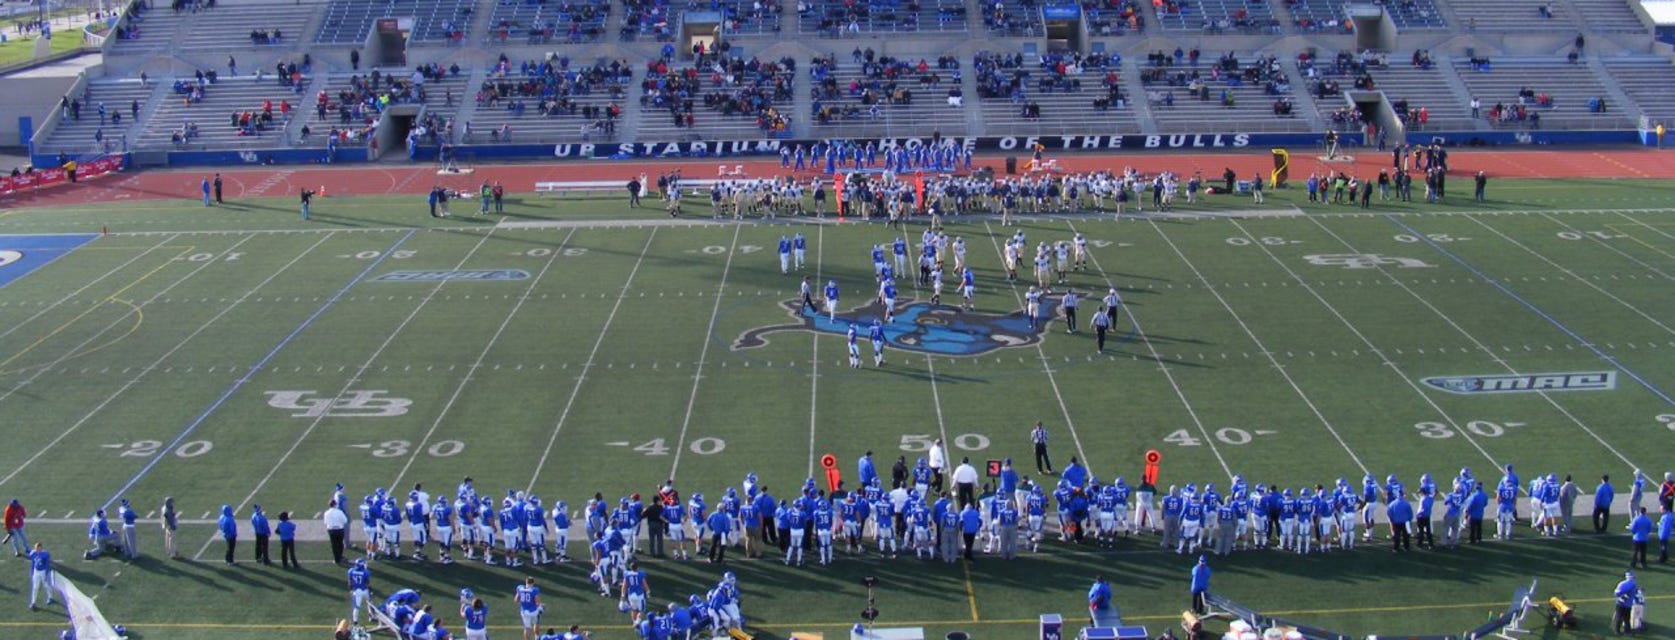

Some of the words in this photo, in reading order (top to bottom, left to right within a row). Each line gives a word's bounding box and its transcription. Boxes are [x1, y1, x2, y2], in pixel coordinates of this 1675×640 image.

[1000, 138, 1040, 149] OF
[1061, 135, 1122, 148] THE
[1145, 133, 1250, 147] BULLS
[988, 461, 999, 476] 3
